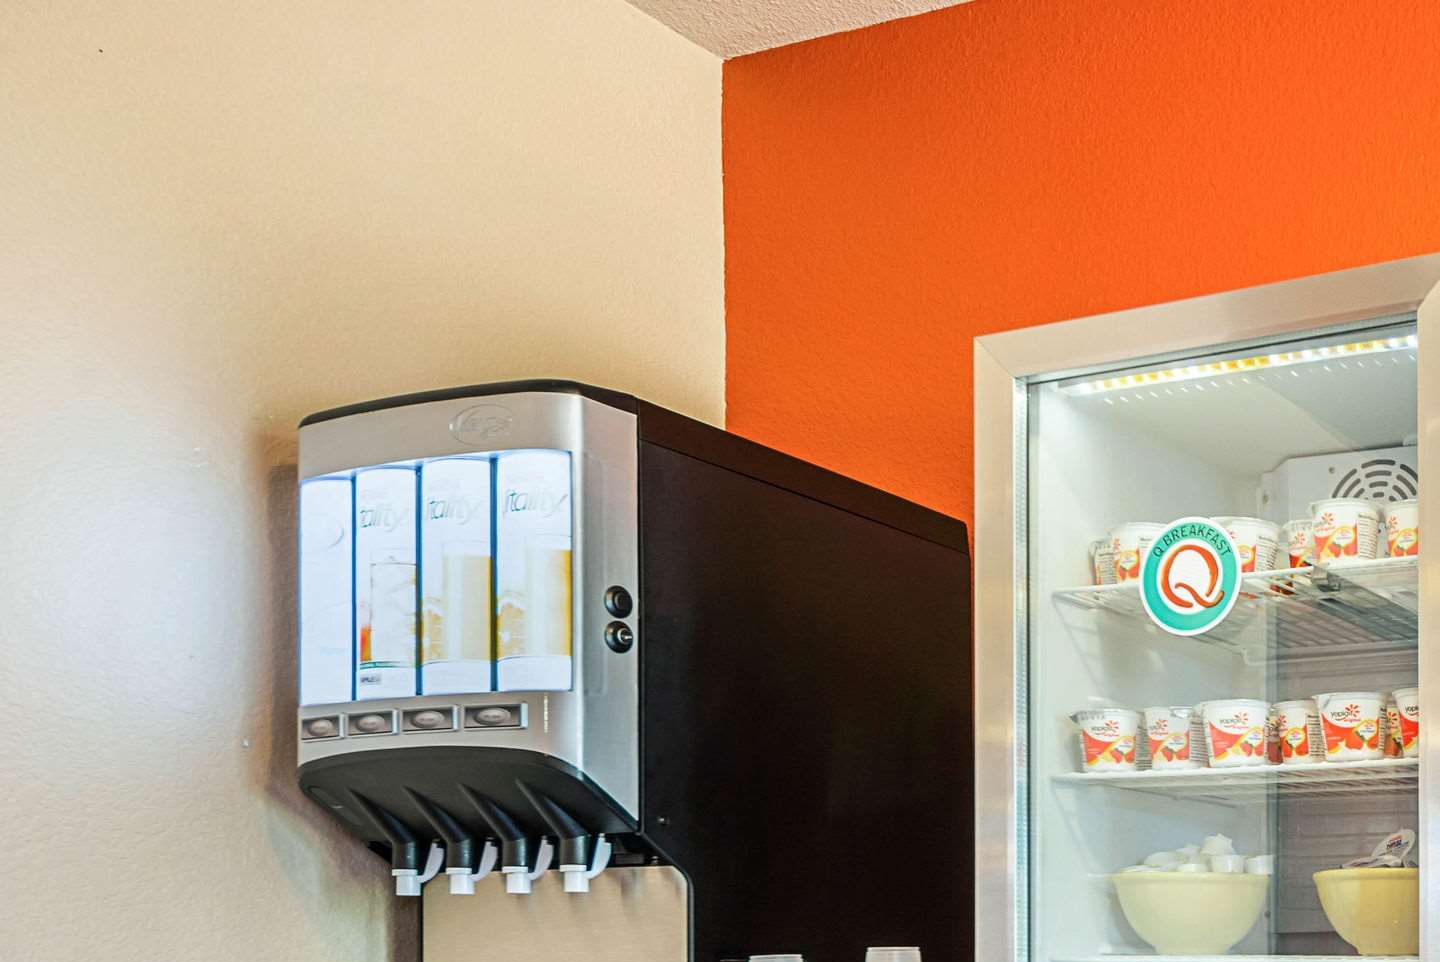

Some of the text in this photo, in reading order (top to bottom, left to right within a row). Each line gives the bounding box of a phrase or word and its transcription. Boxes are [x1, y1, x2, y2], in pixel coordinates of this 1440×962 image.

[1153, 546, 1164, 558] Q
[1163, 524, 1233, 556] BREAKFAST
[1161, 544, 1225, 608] Q
